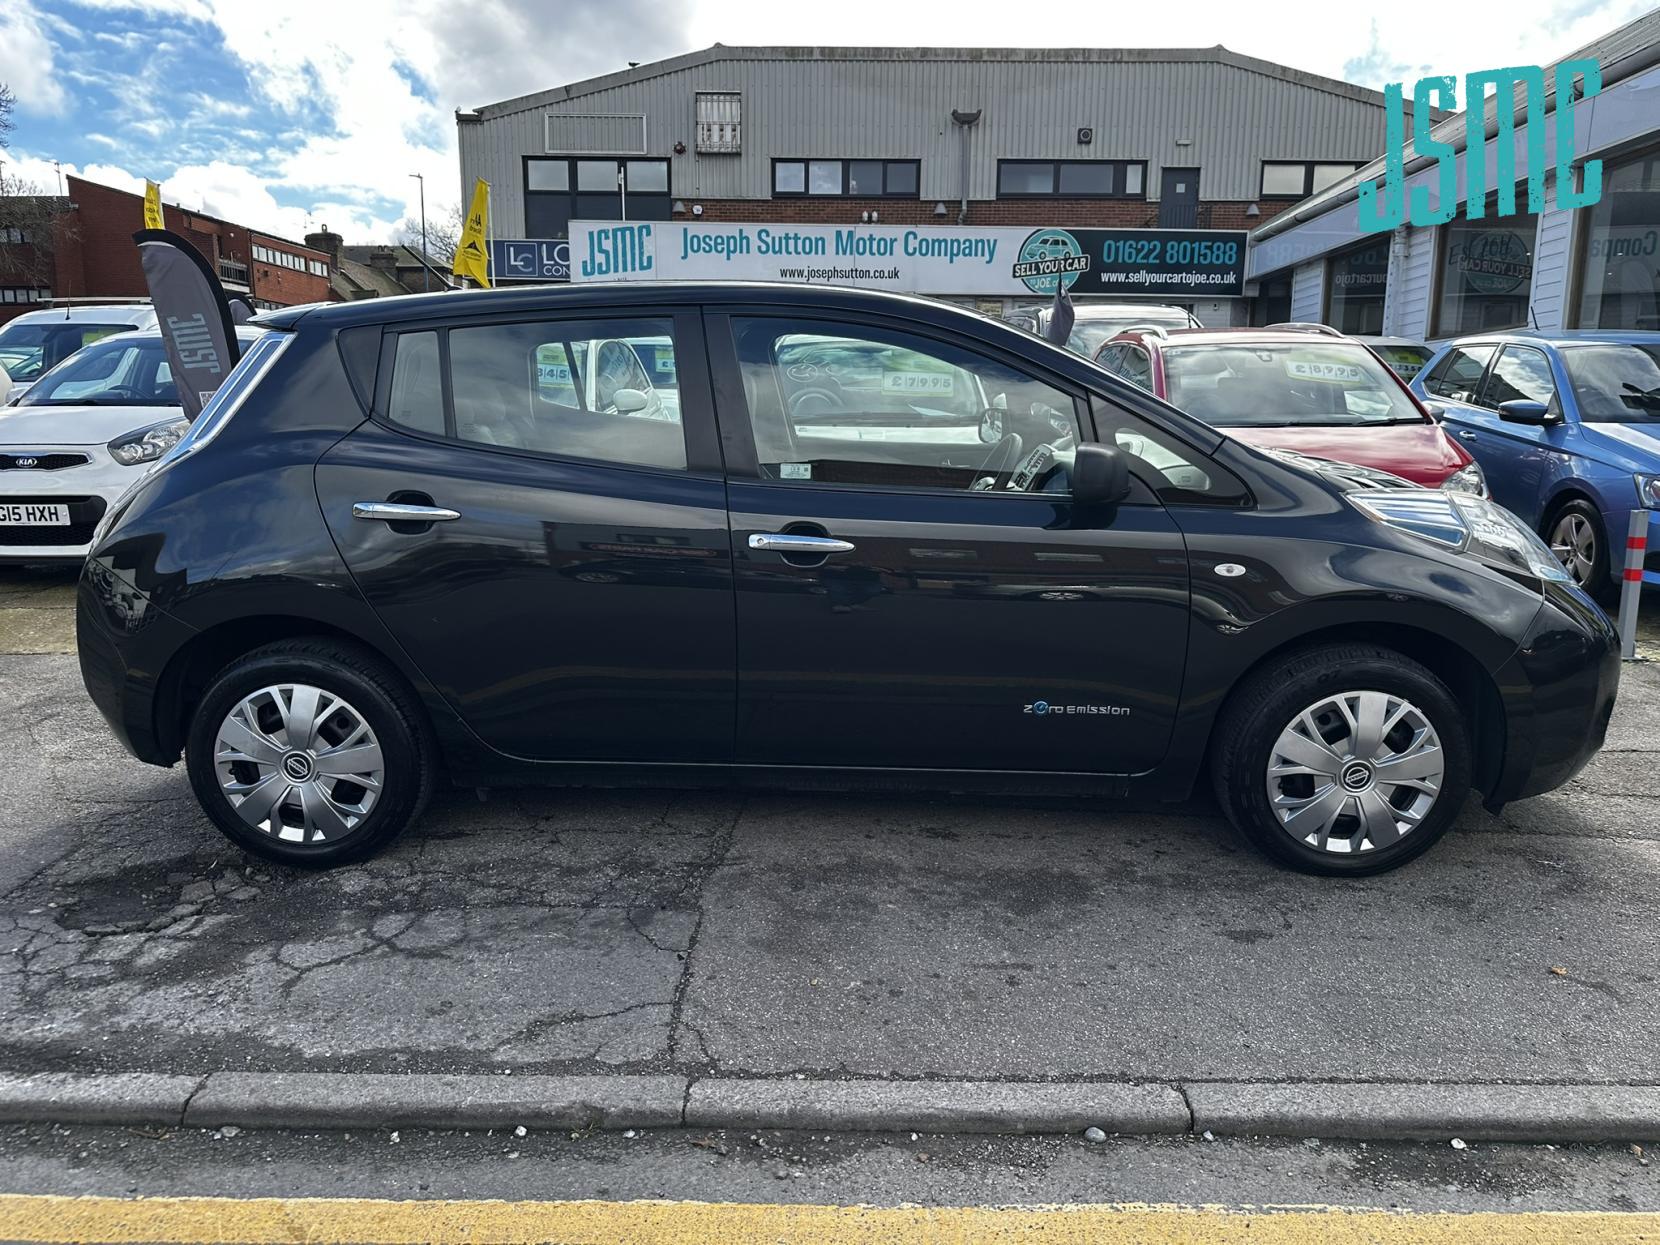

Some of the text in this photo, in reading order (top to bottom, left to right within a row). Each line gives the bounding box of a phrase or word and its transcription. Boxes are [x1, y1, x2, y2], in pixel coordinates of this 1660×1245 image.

[581, 224, 653, 277] JSMC
[681, 227, 998, 264] Joseph Sutton Motor Company
[1102, 239, 1161, 264] 01622
[1165, 240, 1238, 265] 801588
[779, 265, 900, 282] www.josephsutton.co.uk
[1015, 258, 1087, 277] SELL YOUR CAR
[1100, 269, 1237, 287] www.sellyourcartojoe.co.uk
[166, 312, 221, 373] JSMC
[25, 506, 60, 522] HXH
